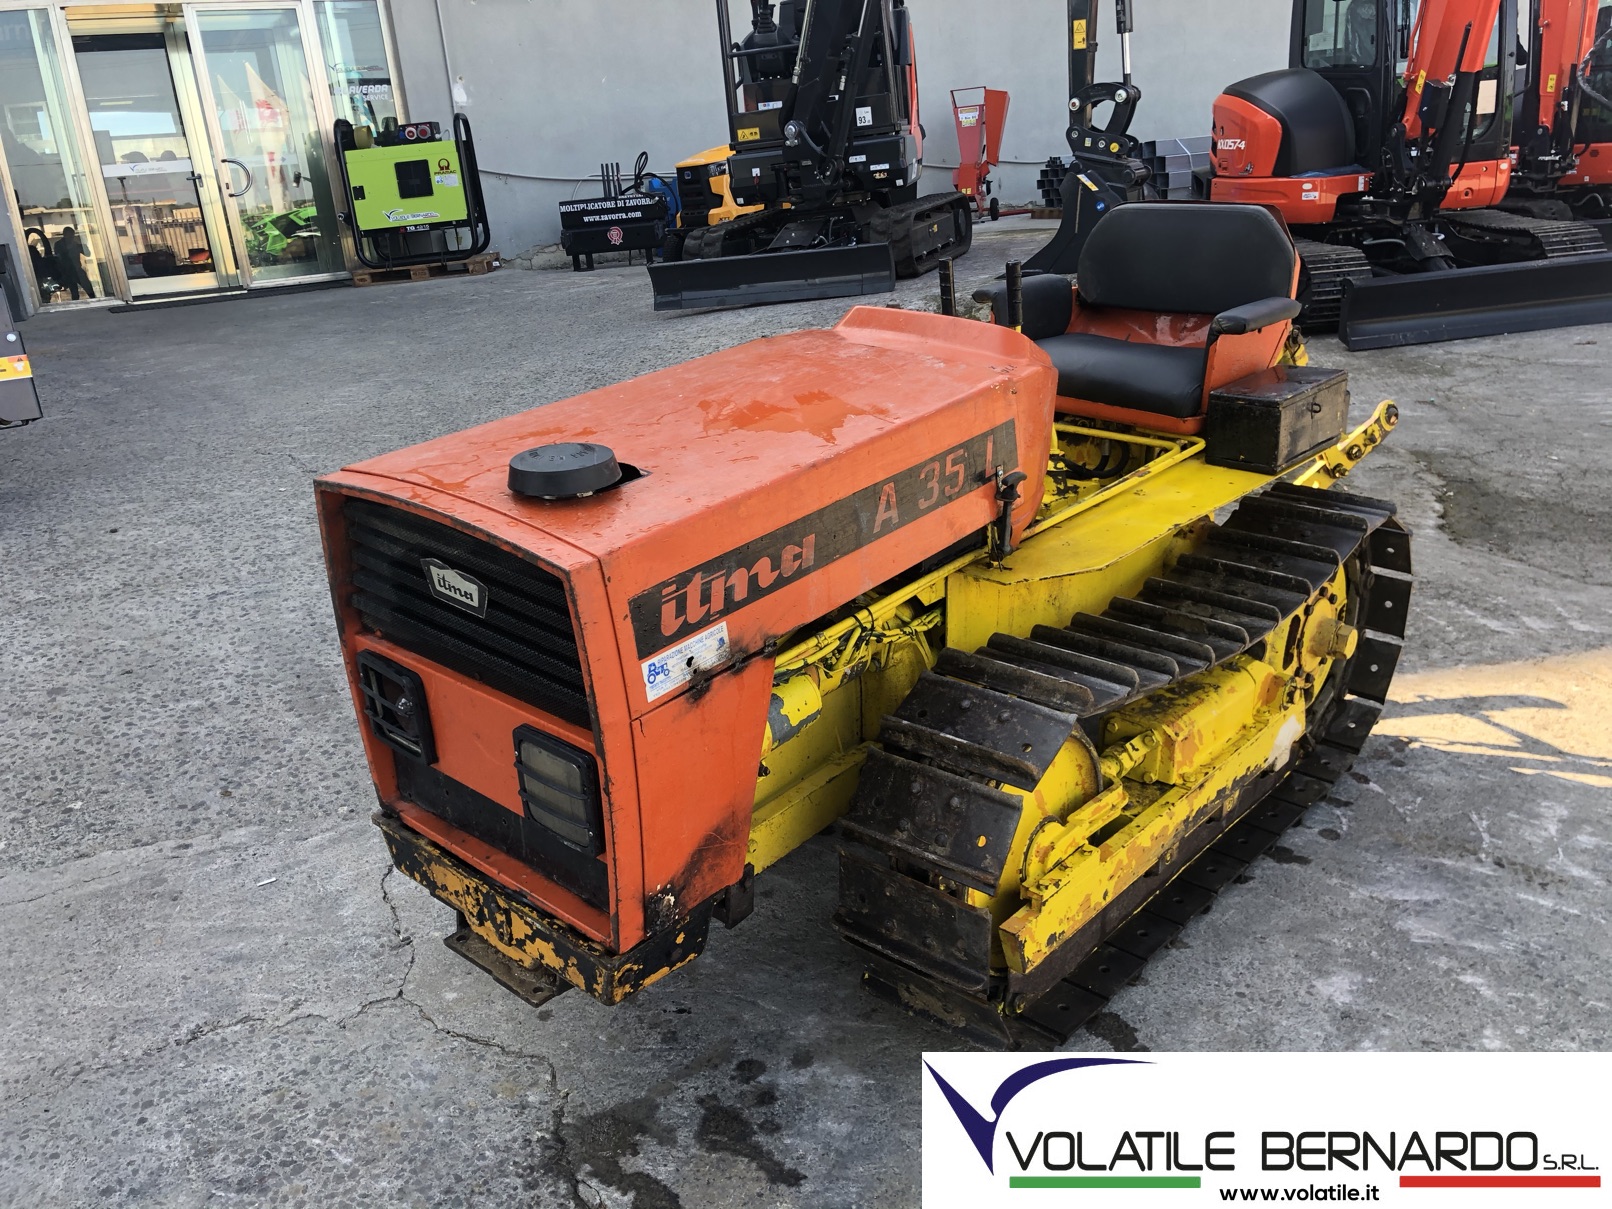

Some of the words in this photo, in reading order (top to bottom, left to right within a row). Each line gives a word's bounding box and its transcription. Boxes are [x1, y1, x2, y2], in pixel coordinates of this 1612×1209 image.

[858, 116, 866, 124] 93
[560, 201, 615, 213] MOLTIPLICATORE
[617, 199, 624, 207] DI
[583, 211, 642, 222] www.zavorra.com
[661, 533, 816, 637] itma
[872, 481, 900, 534] A
[918, 448, 965, 510] 35
[437, 573, 474, 602] itma
[657, 648, 684, 664] RIPARAZIONE
[684, 636, 705, 651] MACCHINE
[705, 626, 724, 640] AGRICOLE
